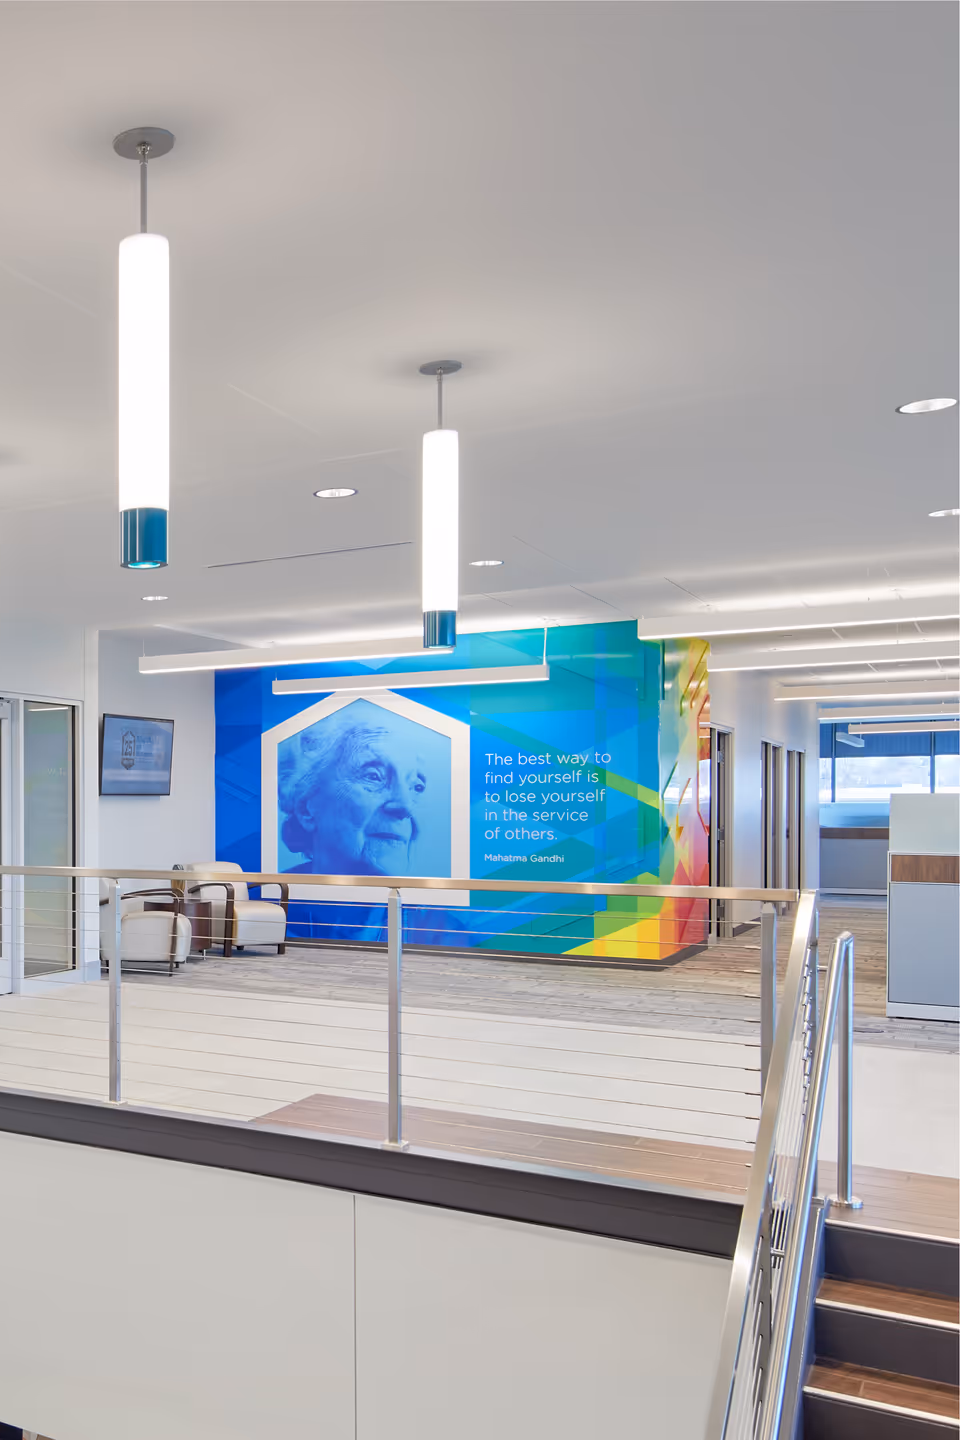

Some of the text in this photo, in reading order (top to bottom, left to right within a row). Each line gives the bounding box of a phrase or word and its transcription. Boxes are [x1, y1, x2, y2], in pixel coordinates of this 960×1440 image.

[484, 751, 612, 766] The best way to
[484, 770, 599, 786] find yourself is
[484, 789, 606, 804] to lose yourself
[484, 809, 589, 821] in the service
[484, 827, 558, 840] of others.
[484, 853, 565, 863] Mahatma Gandhi
